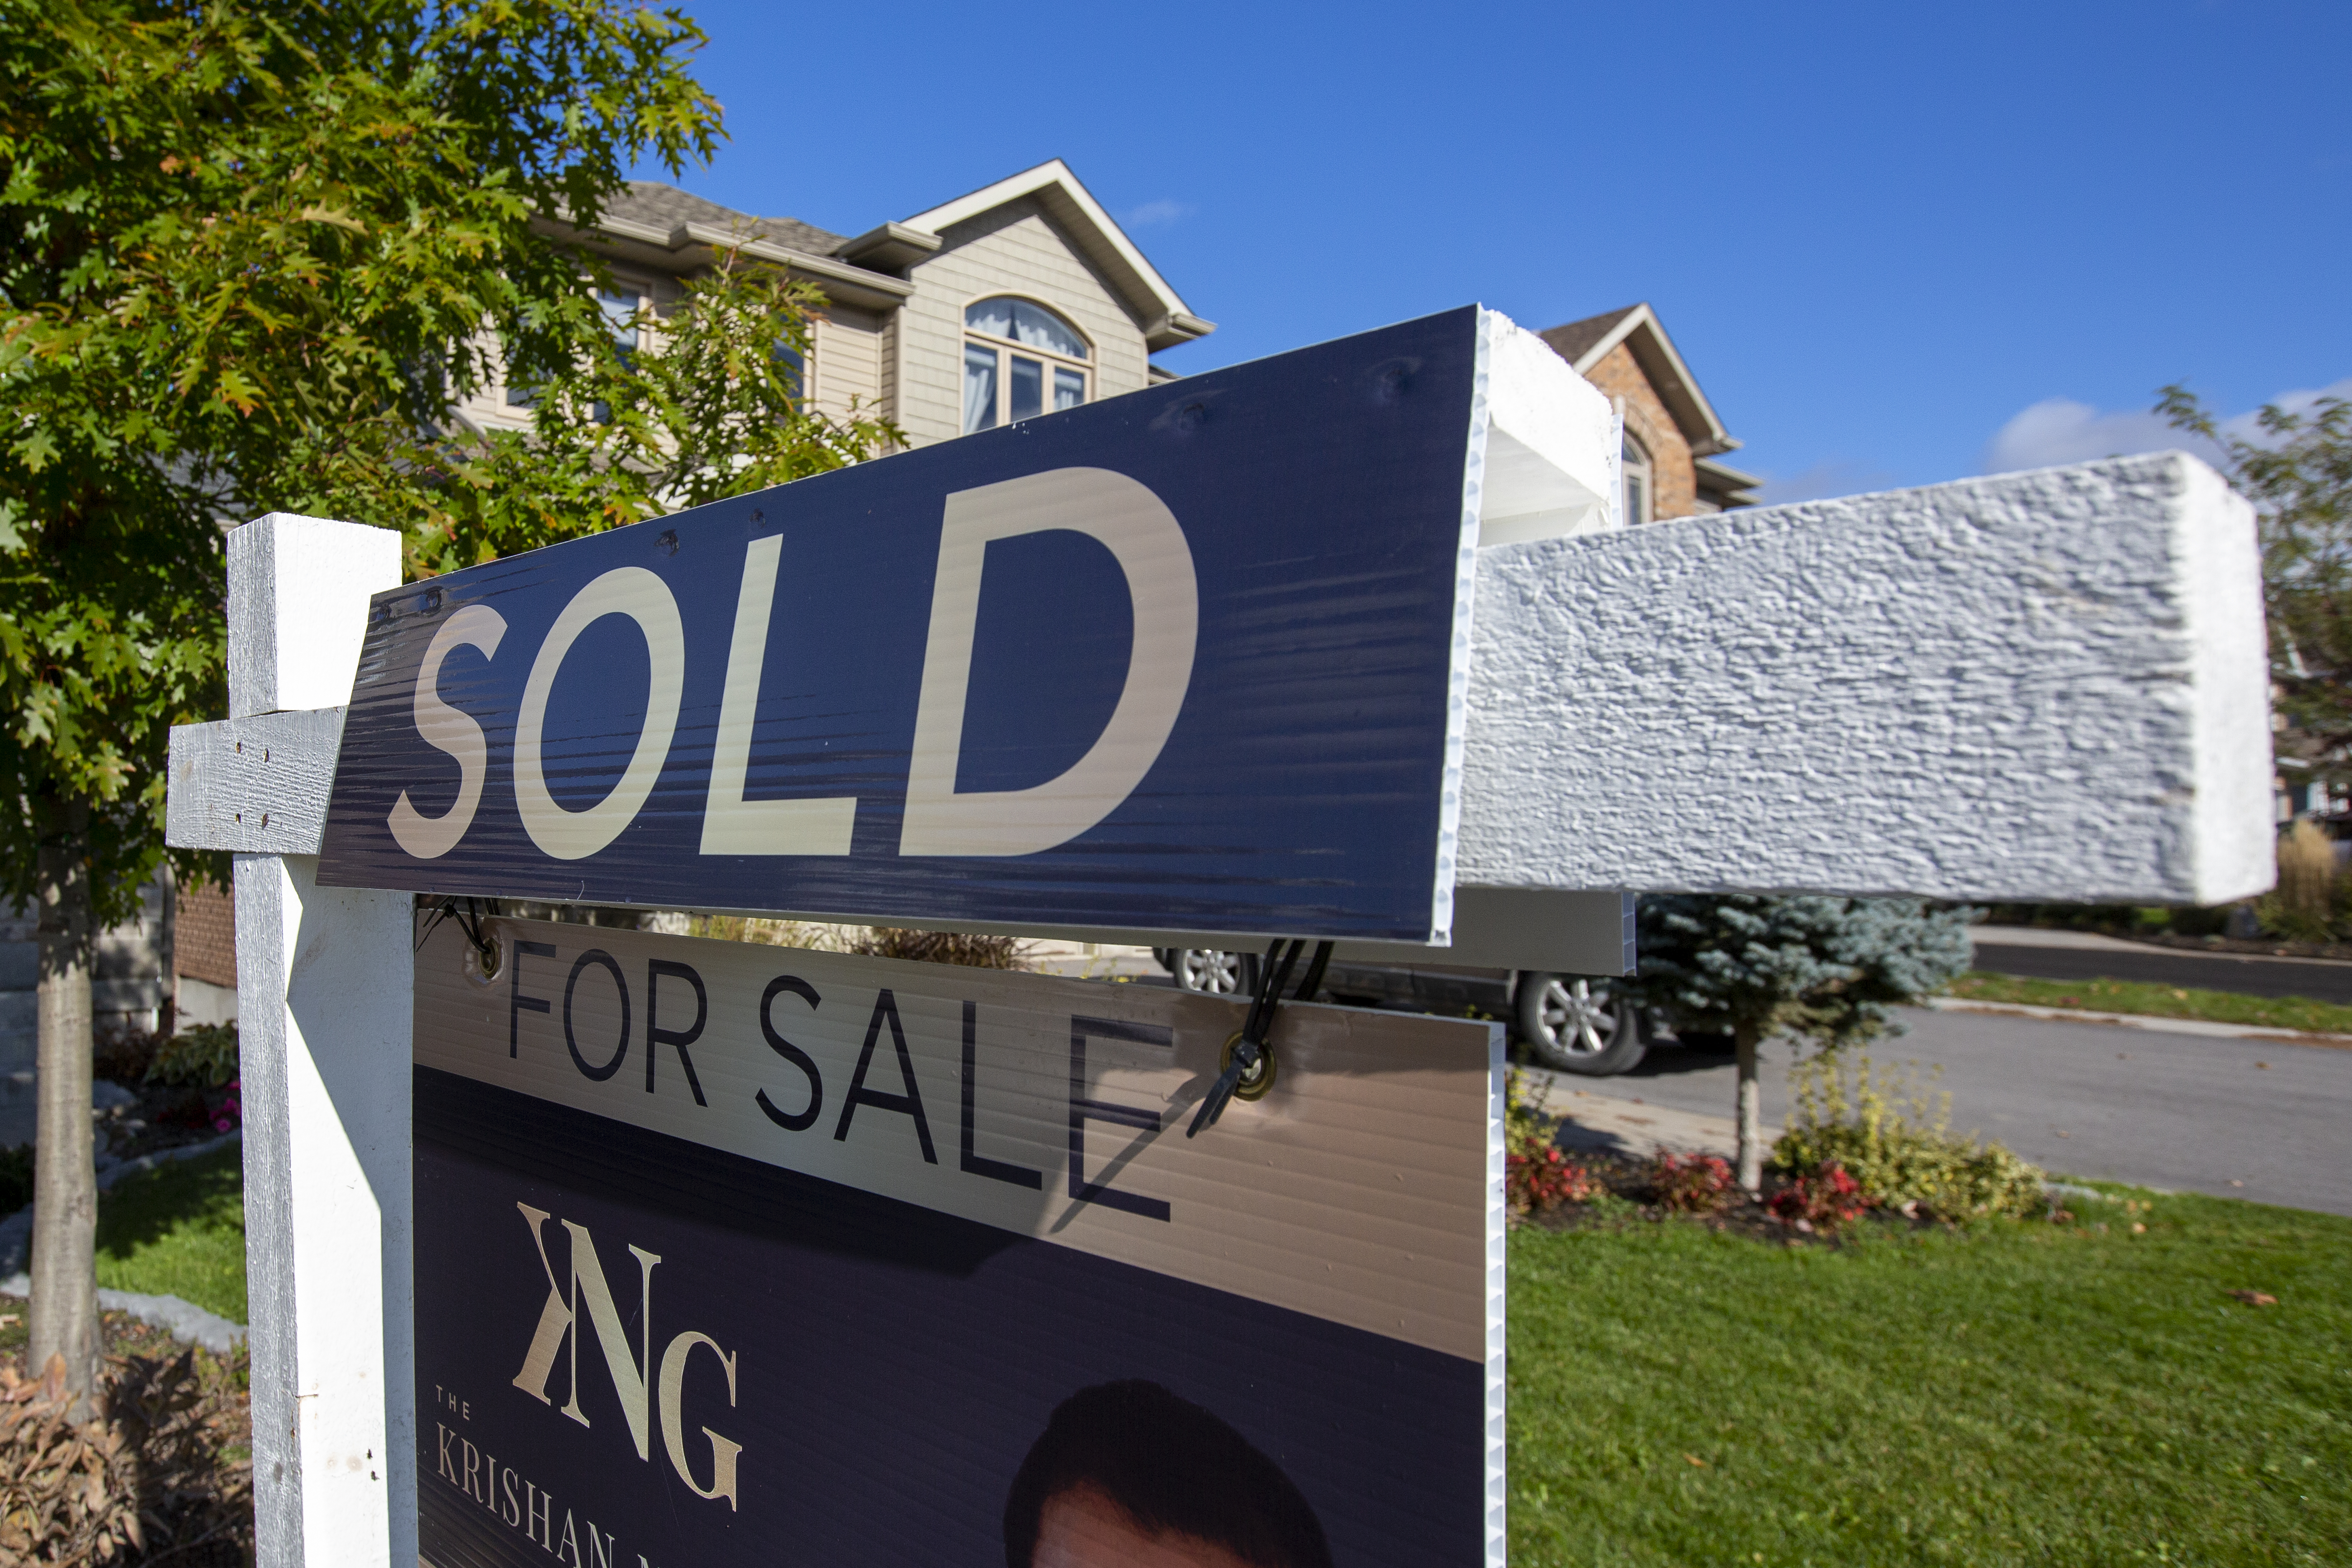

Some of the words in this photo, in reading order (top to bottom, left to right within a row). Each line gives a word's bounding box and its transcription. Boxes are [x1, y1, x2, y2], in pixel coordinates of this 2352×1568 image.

[386, 466, 1199, 860] SOLD
[507, 939, 708, 1108] FOR
[755, 975, 1173, 1223] SALE
[436, 1384, 470, 1420] THE
[437, 1422, 615, 1568] KRISHAN
